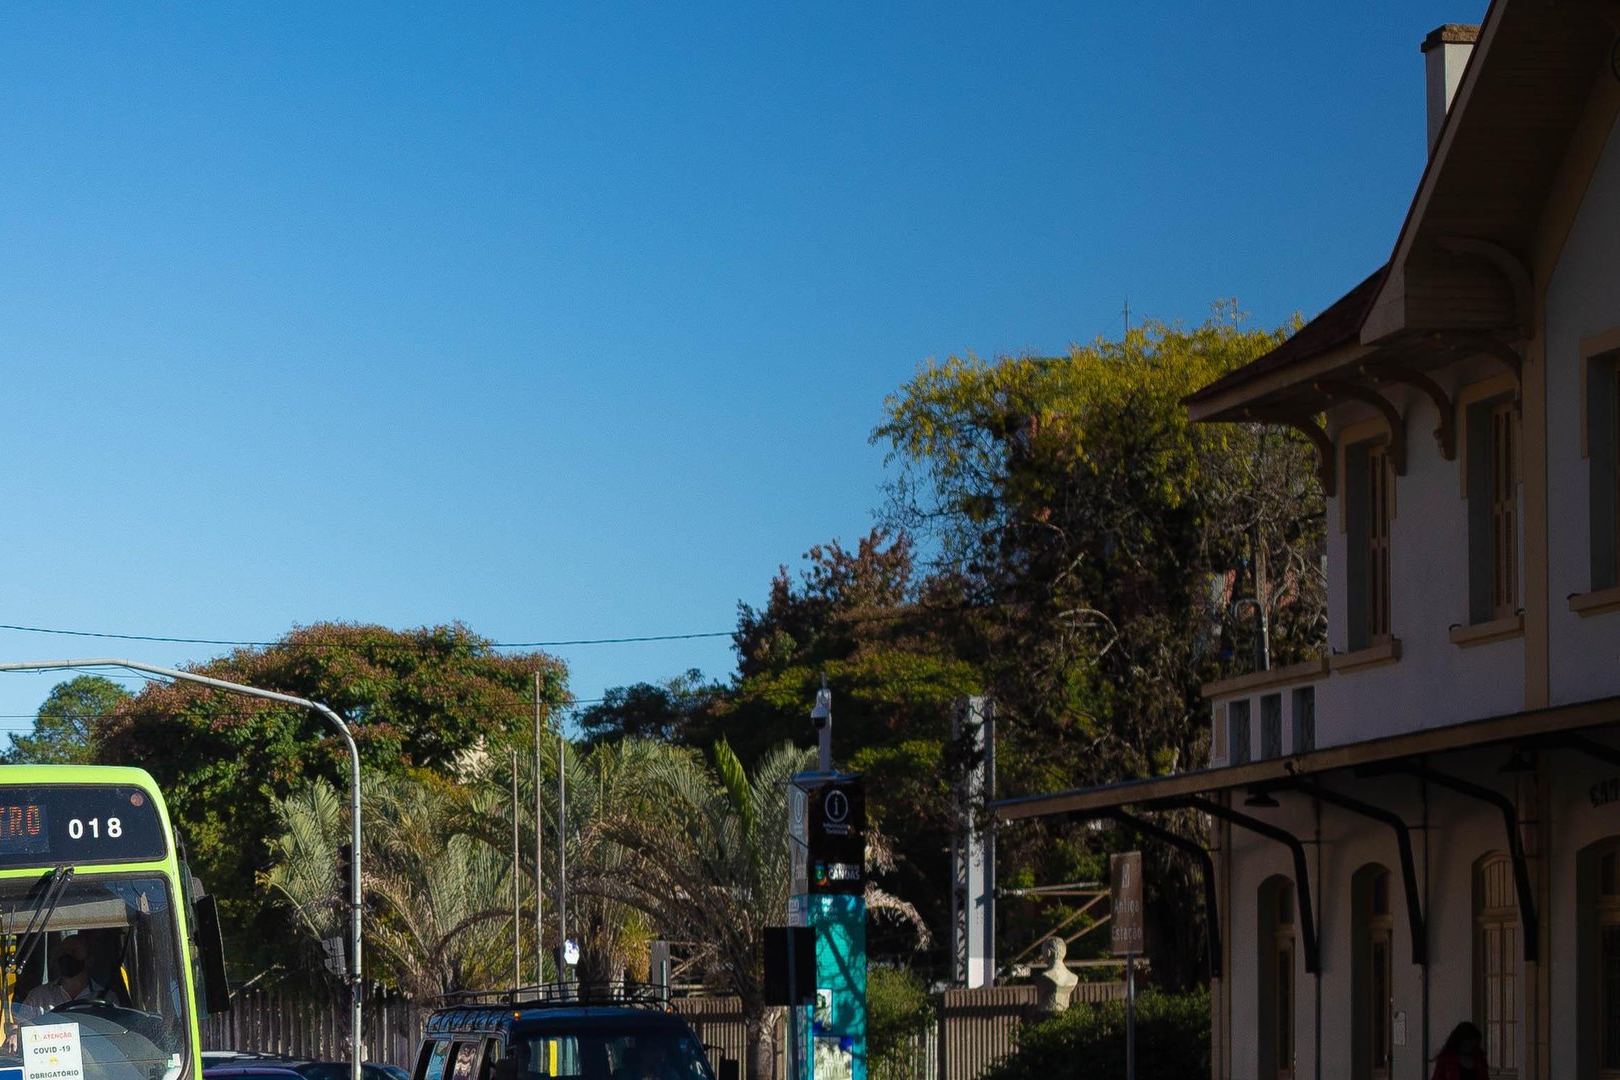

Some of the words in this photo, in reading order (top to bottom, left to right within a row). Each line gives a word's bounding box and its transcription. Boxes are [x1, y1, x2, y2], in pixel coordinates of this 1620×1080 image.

[67, 817, 124, 840] 018
[43, 1032, 72, 1040] ATENÇÃO
[33, 1046, 57, 1054] COVID
[30, 1069, 79, 1079] OBRIGATÓRIO
